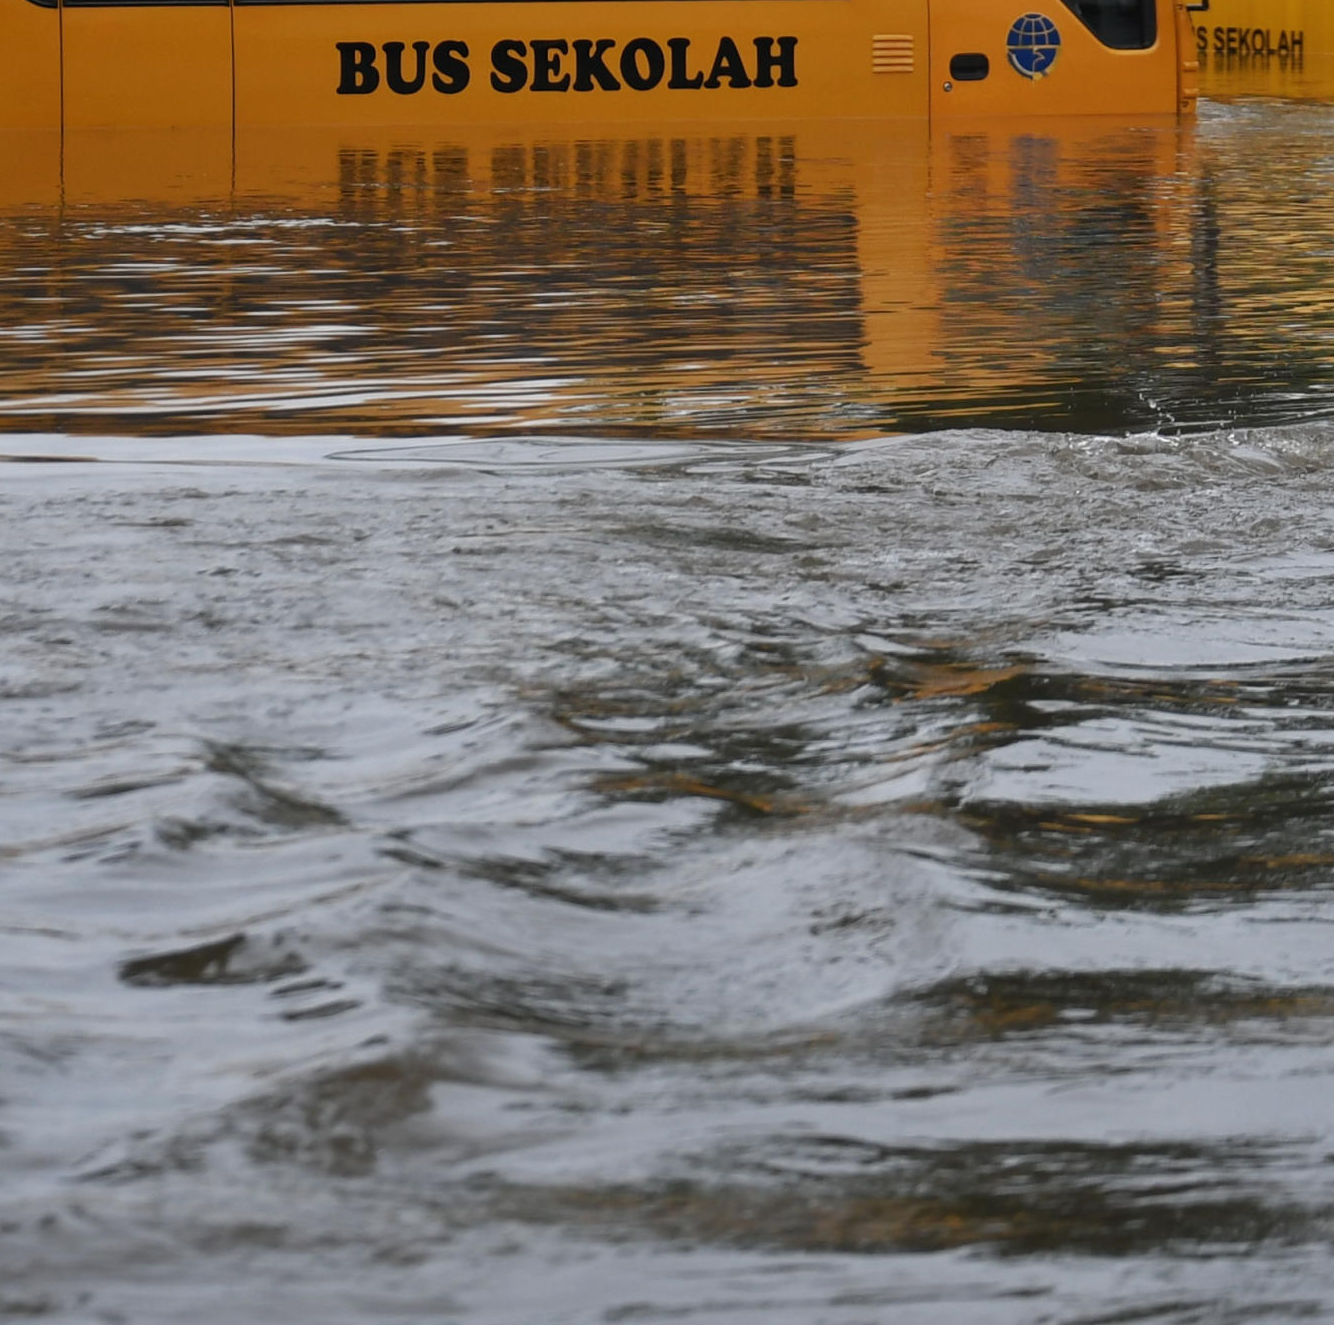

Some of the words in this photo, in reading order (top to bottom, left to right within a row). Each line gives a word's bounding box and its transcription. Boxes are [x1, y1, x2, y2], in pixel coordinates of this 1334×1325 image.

[1213, 26, 1304, 55] SEKOLAH
[335, 40, 471, 95] BUS
[489, 35, 799, 94] SEKOLAH
